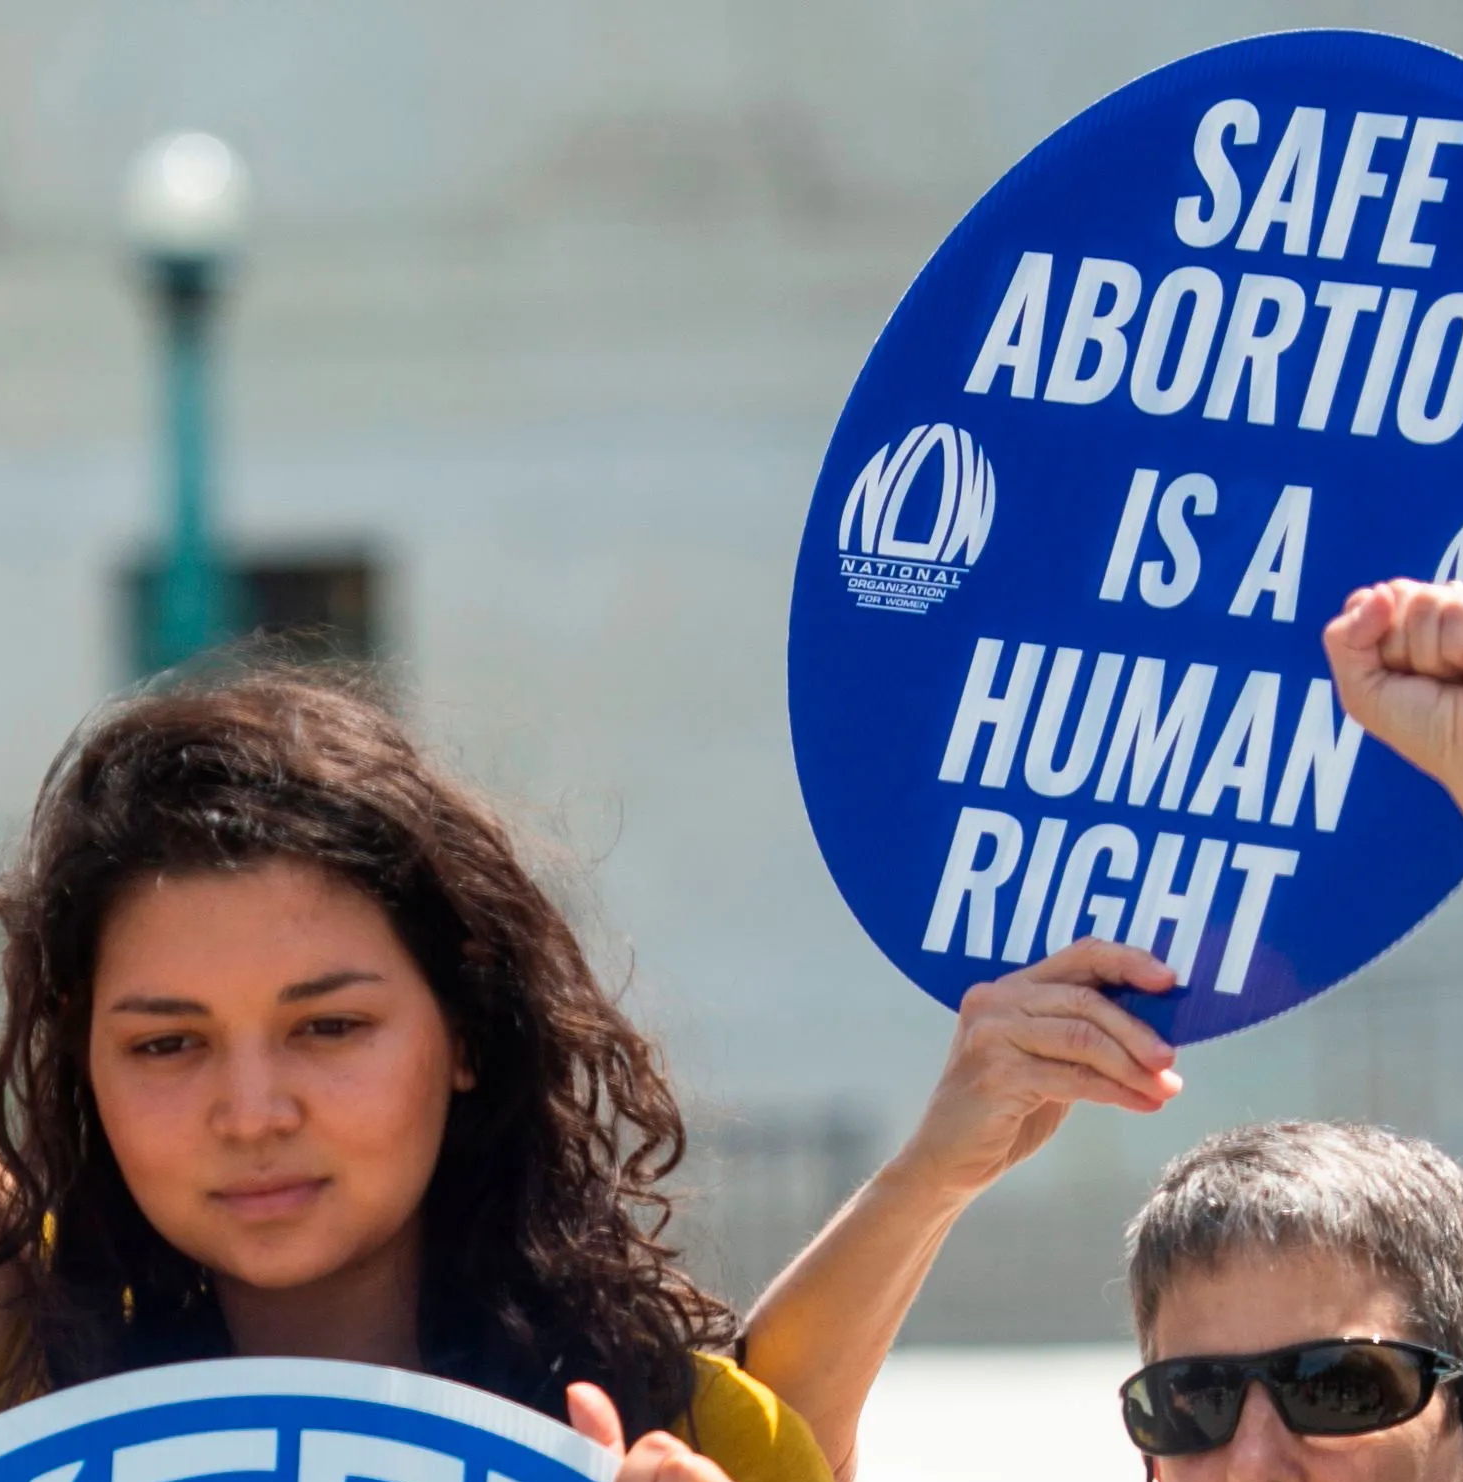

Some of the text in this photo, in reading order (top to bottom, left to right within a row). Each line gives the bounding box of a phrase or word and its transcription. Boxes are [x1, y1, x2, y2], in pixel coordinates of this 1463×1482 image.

[838, 423, 996, 566] NOW
[1099, 468, 1313, 622] IS A
[841, 559, 961, 585] NATIONAL
[848, 577, 946, 599] ORGANIZATION
[857, 594, 929, 610] FOR WOMEN
[938, 637, 1365, 833] HUMAN
[921, 806, 1300, 996] RIGHT
